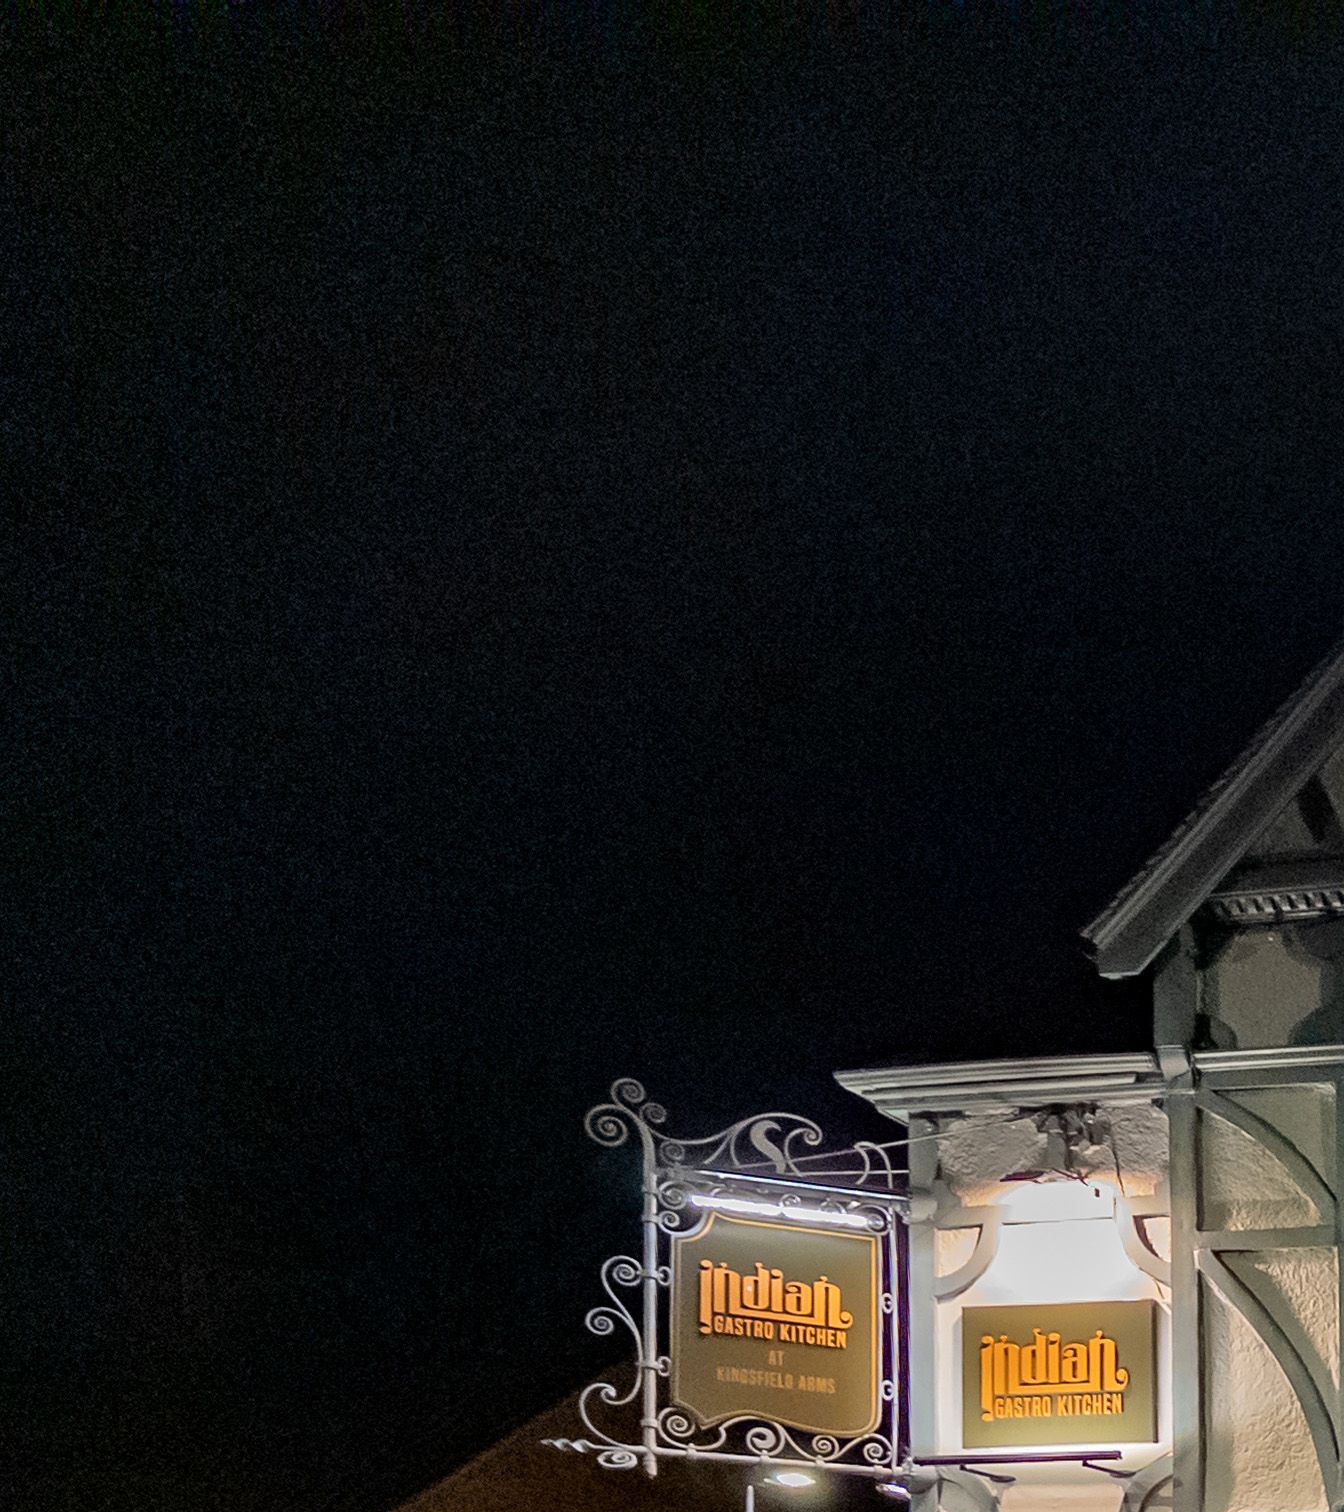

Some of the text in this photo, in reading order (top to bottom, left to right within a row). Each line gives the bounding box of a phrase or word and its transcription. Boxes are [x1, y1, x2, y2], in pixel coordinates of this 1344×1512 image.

[714, 1315, 847, 1349] GASTRO KITCHEN
[768, 1350, 785, 1366] AT
[716, 1366, 836, 1394] KINGSFIELD ARMS
[995, 1392, 1123, 1419] GASTRO KITCHEN
